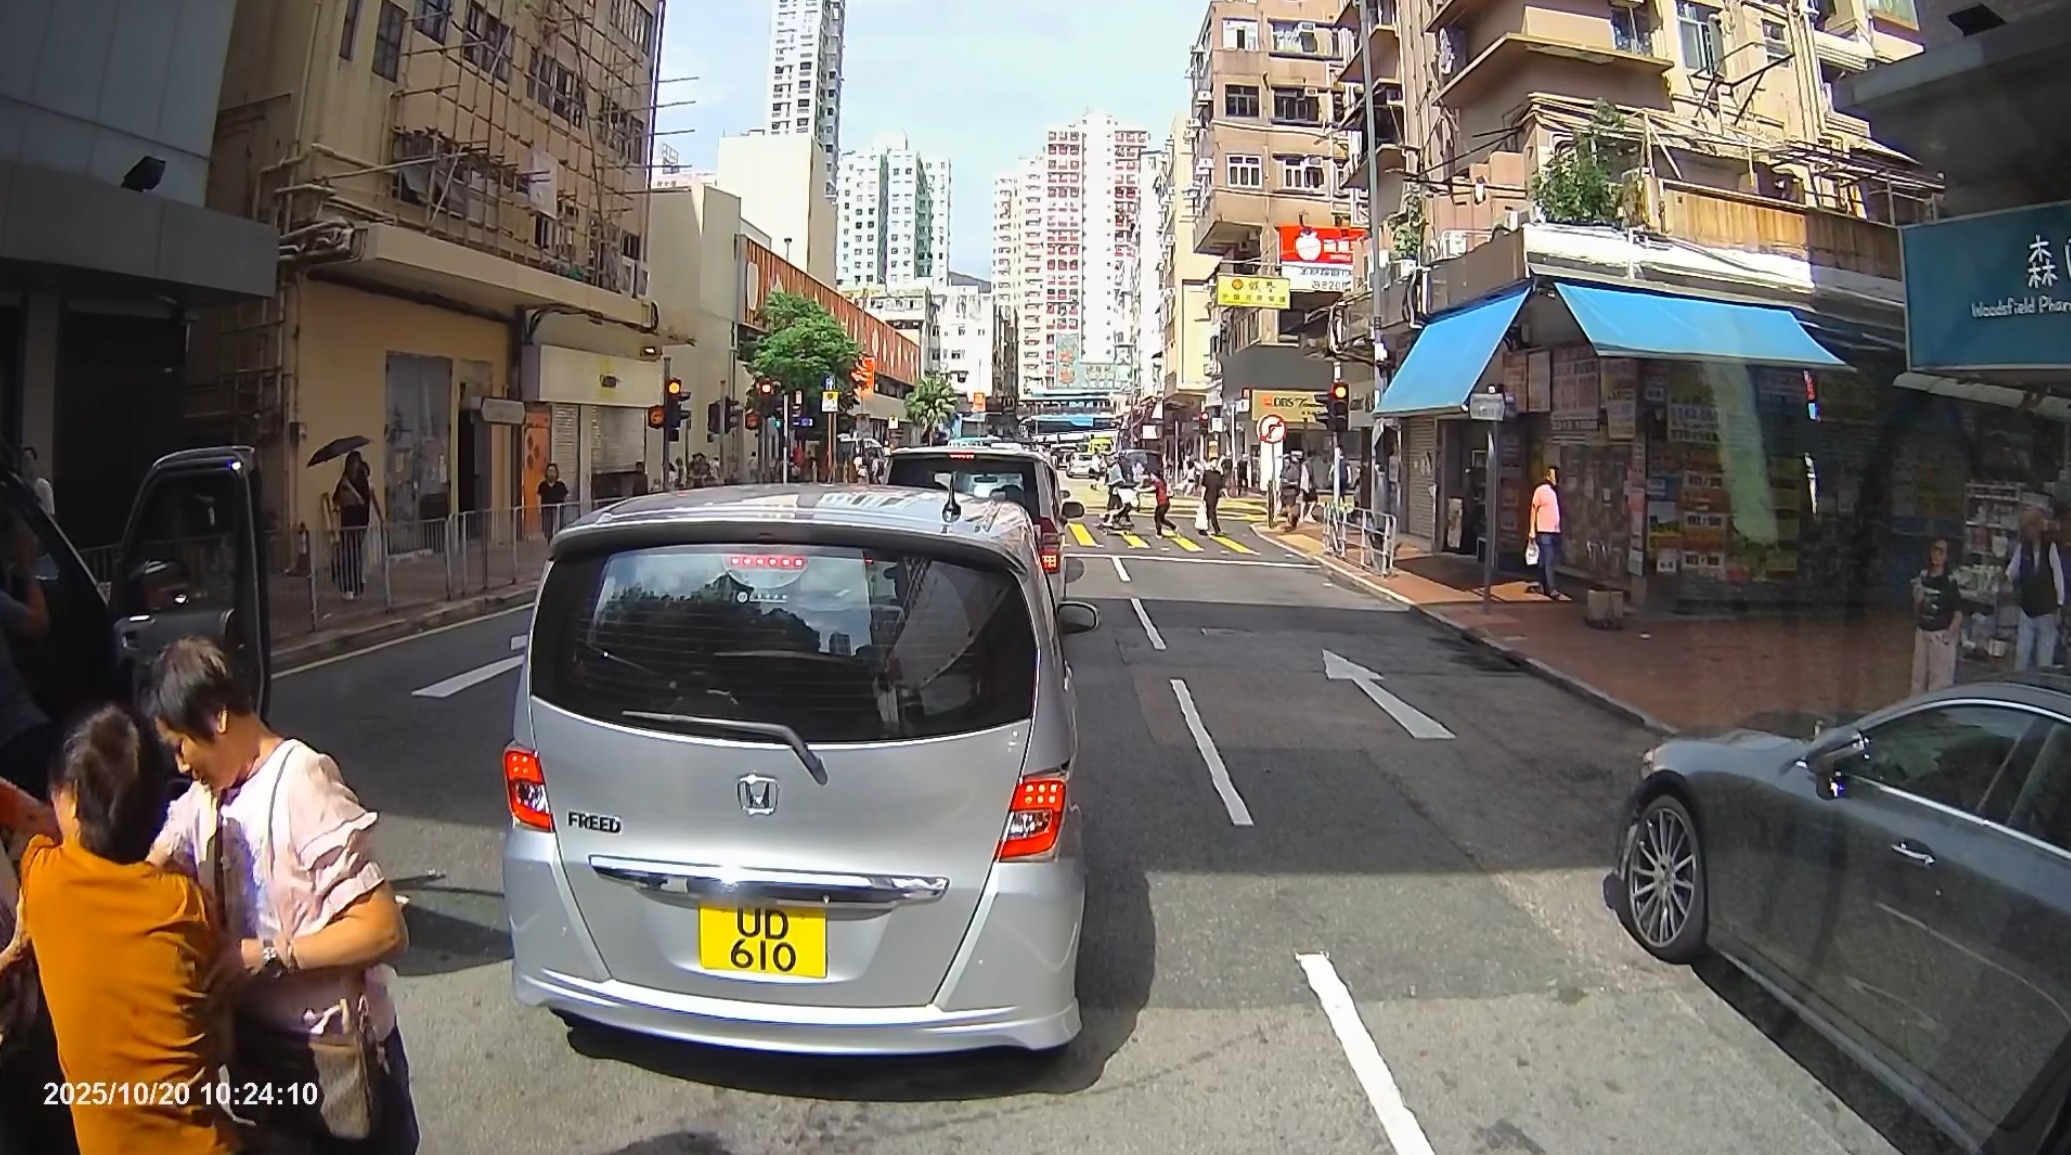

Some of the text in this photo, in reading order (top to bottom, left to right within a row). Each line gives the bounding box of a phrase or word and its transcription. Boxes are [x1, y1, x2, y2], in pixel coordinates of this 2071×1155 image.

[2028, 234, 2071, 289] 森
[1971, 297, 2036, 318] Woodsfield
[1273, 397, 1294, 408] DBS
[568, 811, 622, 834] FREED
[736, 907, 789, 940] UD
[730, 938, 797, 973] 610
